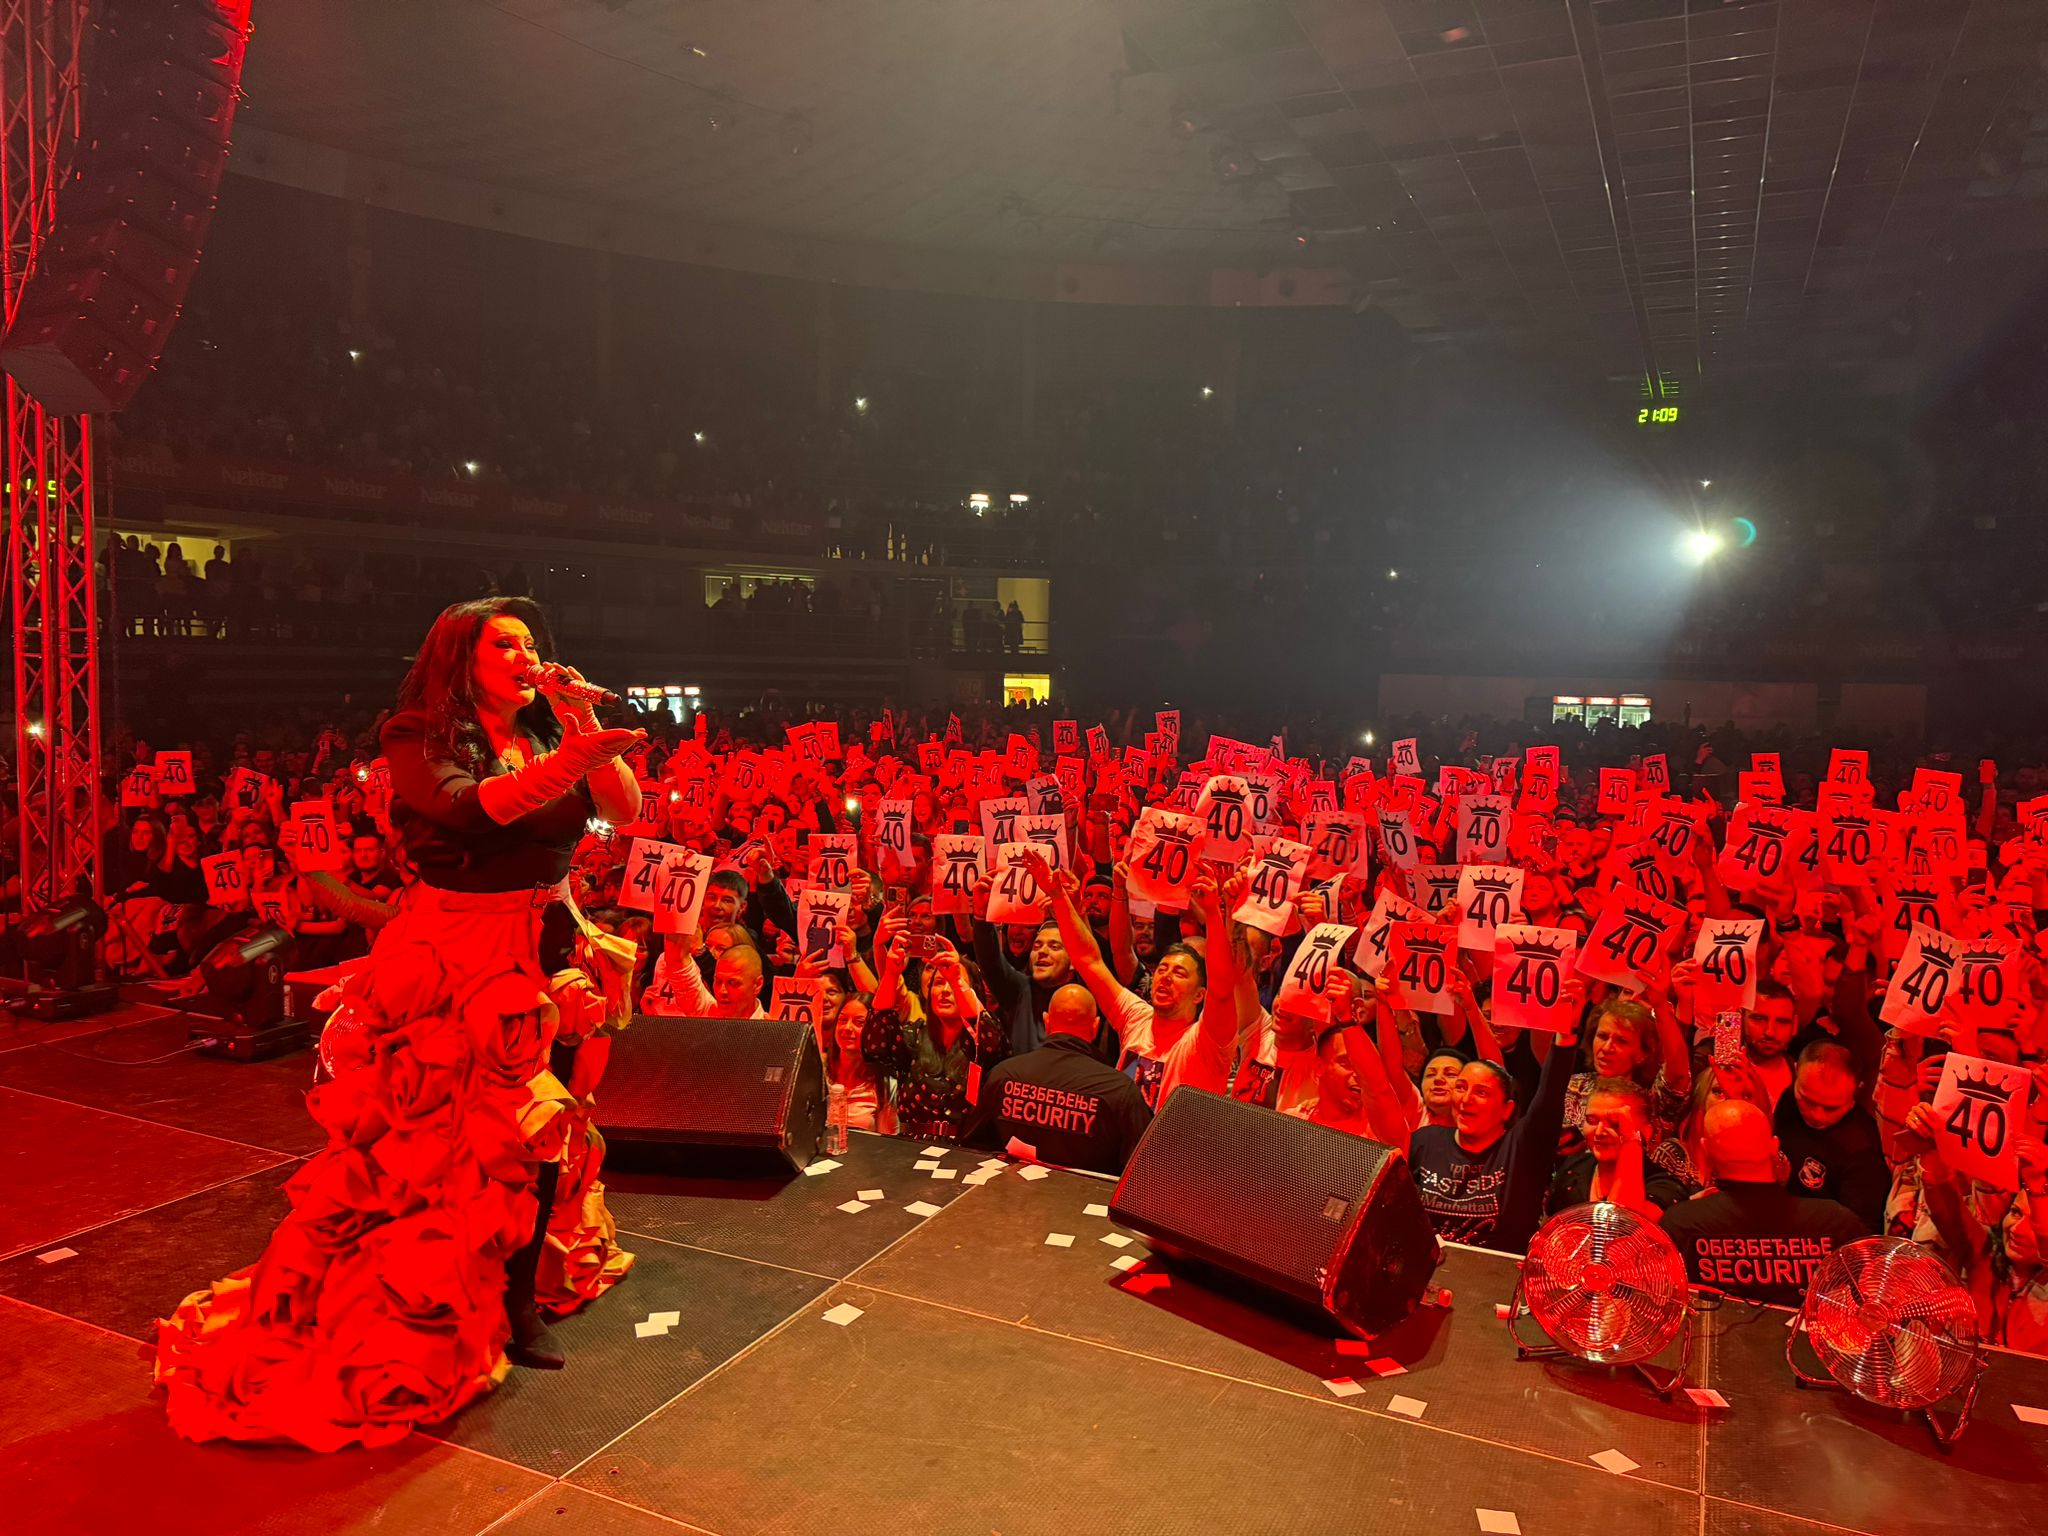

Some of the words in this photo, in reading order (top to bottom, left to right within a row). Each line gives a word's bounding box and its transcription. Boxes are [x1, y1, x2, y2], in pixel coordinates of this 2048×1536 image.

[1638, 407, 1678, 423] 21:09
[803, 739, 823, 760] 40
[1057, 729, 1073, 744] 40
[926, 754, 942, 768] 40
[1011, 753, 1028, 769] 40
[1397, 750, 1413, 766] 40
[163, 765, 187, 784] 40
[1060, 771, 1078, 790] 40
[1647, 767, 1664, 784] 40
[684, 785, 704, 807] 40
[1528, 782, 1549, 800] 40
[1606, 783, 1629, 803] 40
[1920, 790, 1948, 811] 40
[880, 821, 905, 852] 40
[1208, 802, 1243, 841] 40
[1467, 817, 1500, 848] 40
[300, 823, 329, 854] 40
[1317, 833, 1347, 865] 40
[1650, 821, 1691, 856] 40
[1827, 829, 1870, 866] 40
[1143, 843, 1188, 885] 40
[1734, 835, 1782, 877] 40
[1800, 839, 1819, 871] 4
[215, 867, 240, 890] 40
[815, 857, 850, 891] 40
[943, 863, 978, 897] 40
[1000, 870, 1038, 905] 40
[1250, 865, 1289, 910] 40
[661, 878, 696, 914] 40
[1467, 891, 1511, 931] 40
[1370, 923, 1389, 962] 4
[1602, 922, 1659, 971] 40
[1294, 948, 1329, 994] 40
[1399, 953, 1445, 993] 40
[1703, 945, 1747, 986] 40
[660, 981, 675, 1005] 4
[1507, 958, 1559, 1008] 40
[1901, 961, 1949, 1015] 40
[1004, 1080, 1099, 1112] ОБЕЗБЕЂЕЊЕ
[1001, 1097, 1097, 1134] SECURITY
[1946, 1097, 2005, 1157] 40
[1466, 1168, 1506, 1194] SIDE
[1696, 1237, 1832, 1257] ОБЕЗБЕЂЕЊЕ
[1698, 1258, 1823, 1284] SECURIT
